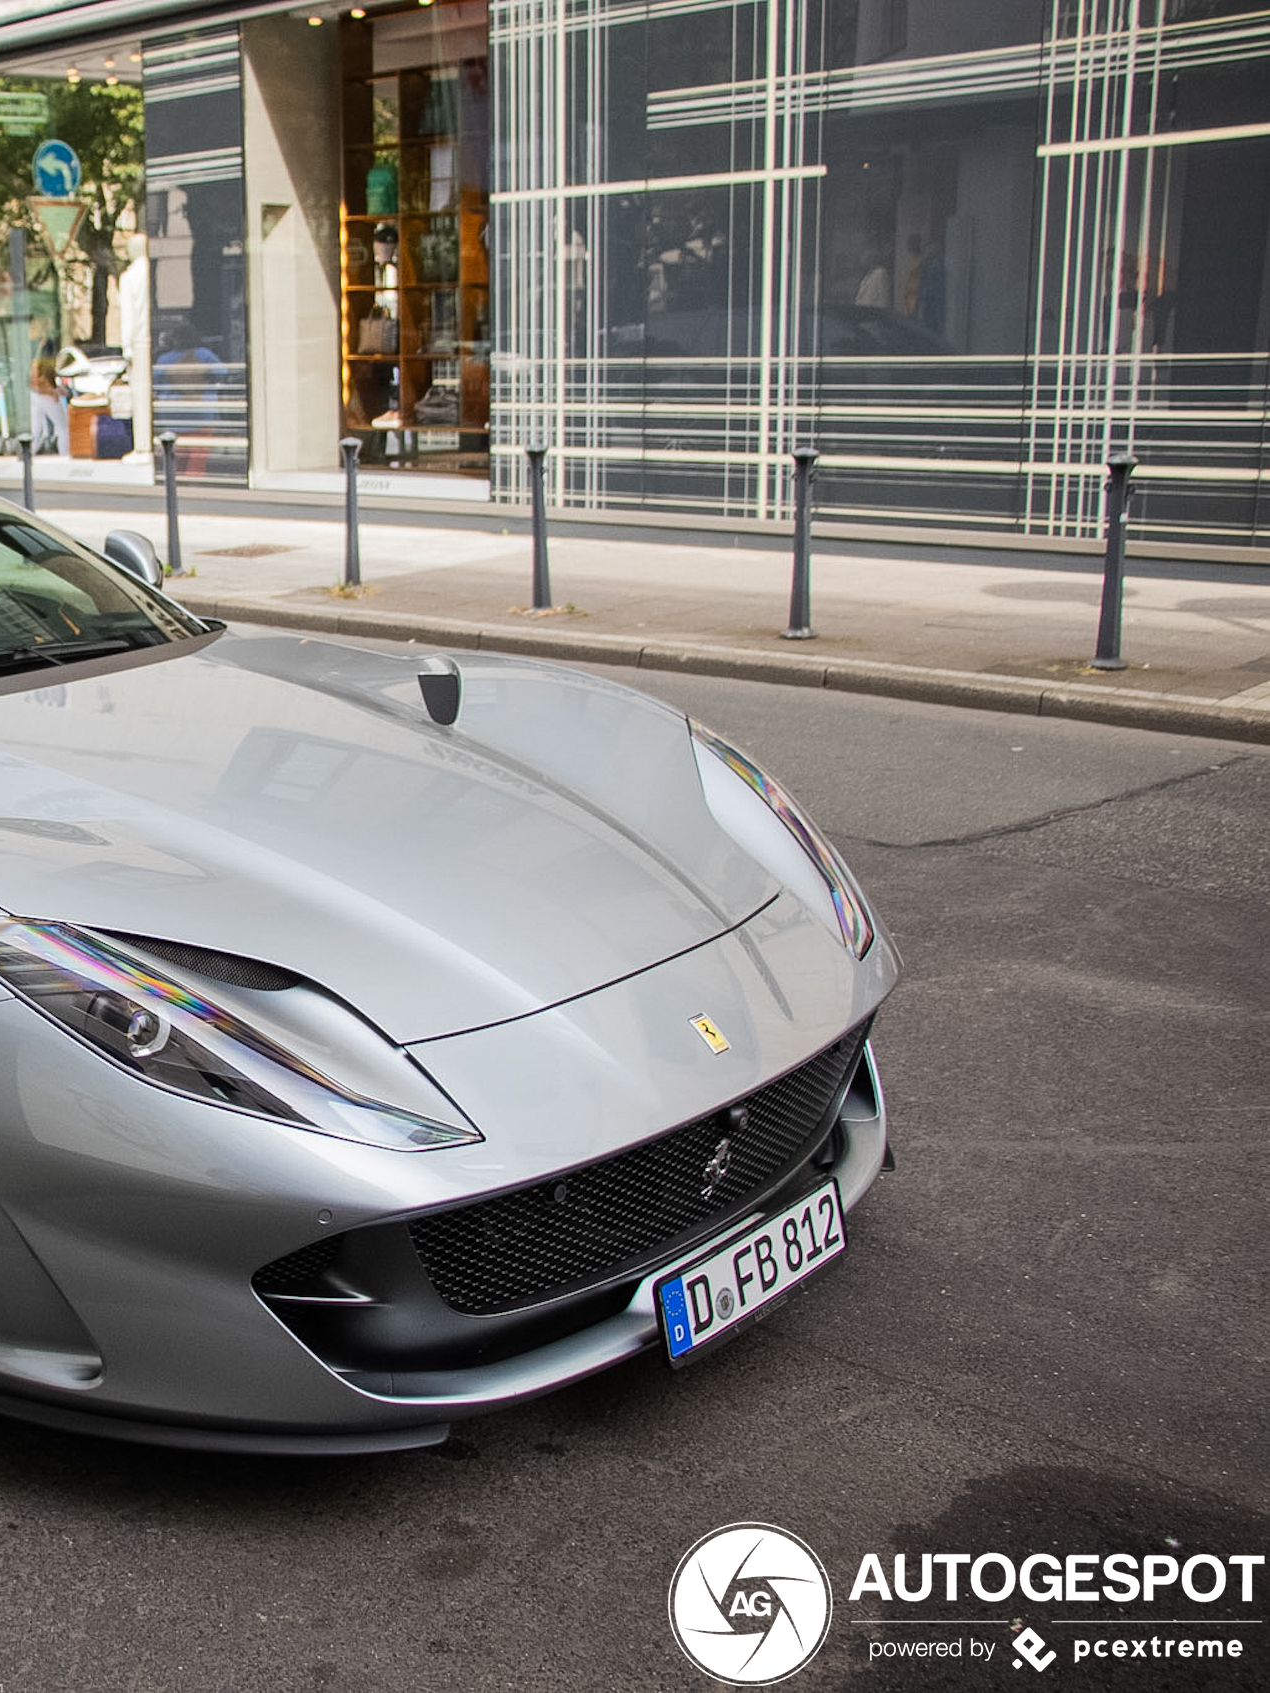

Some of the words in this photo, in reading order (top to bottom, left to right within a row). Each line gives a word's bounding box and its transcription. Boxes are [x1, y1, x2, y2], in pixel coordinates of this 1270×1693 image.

[686, 1273, 714, 1336] D
[733, 1235, 778, 1307] FB
[782, 1194, 840, 1272] 812
[674, 1324, 685, 1342] D
